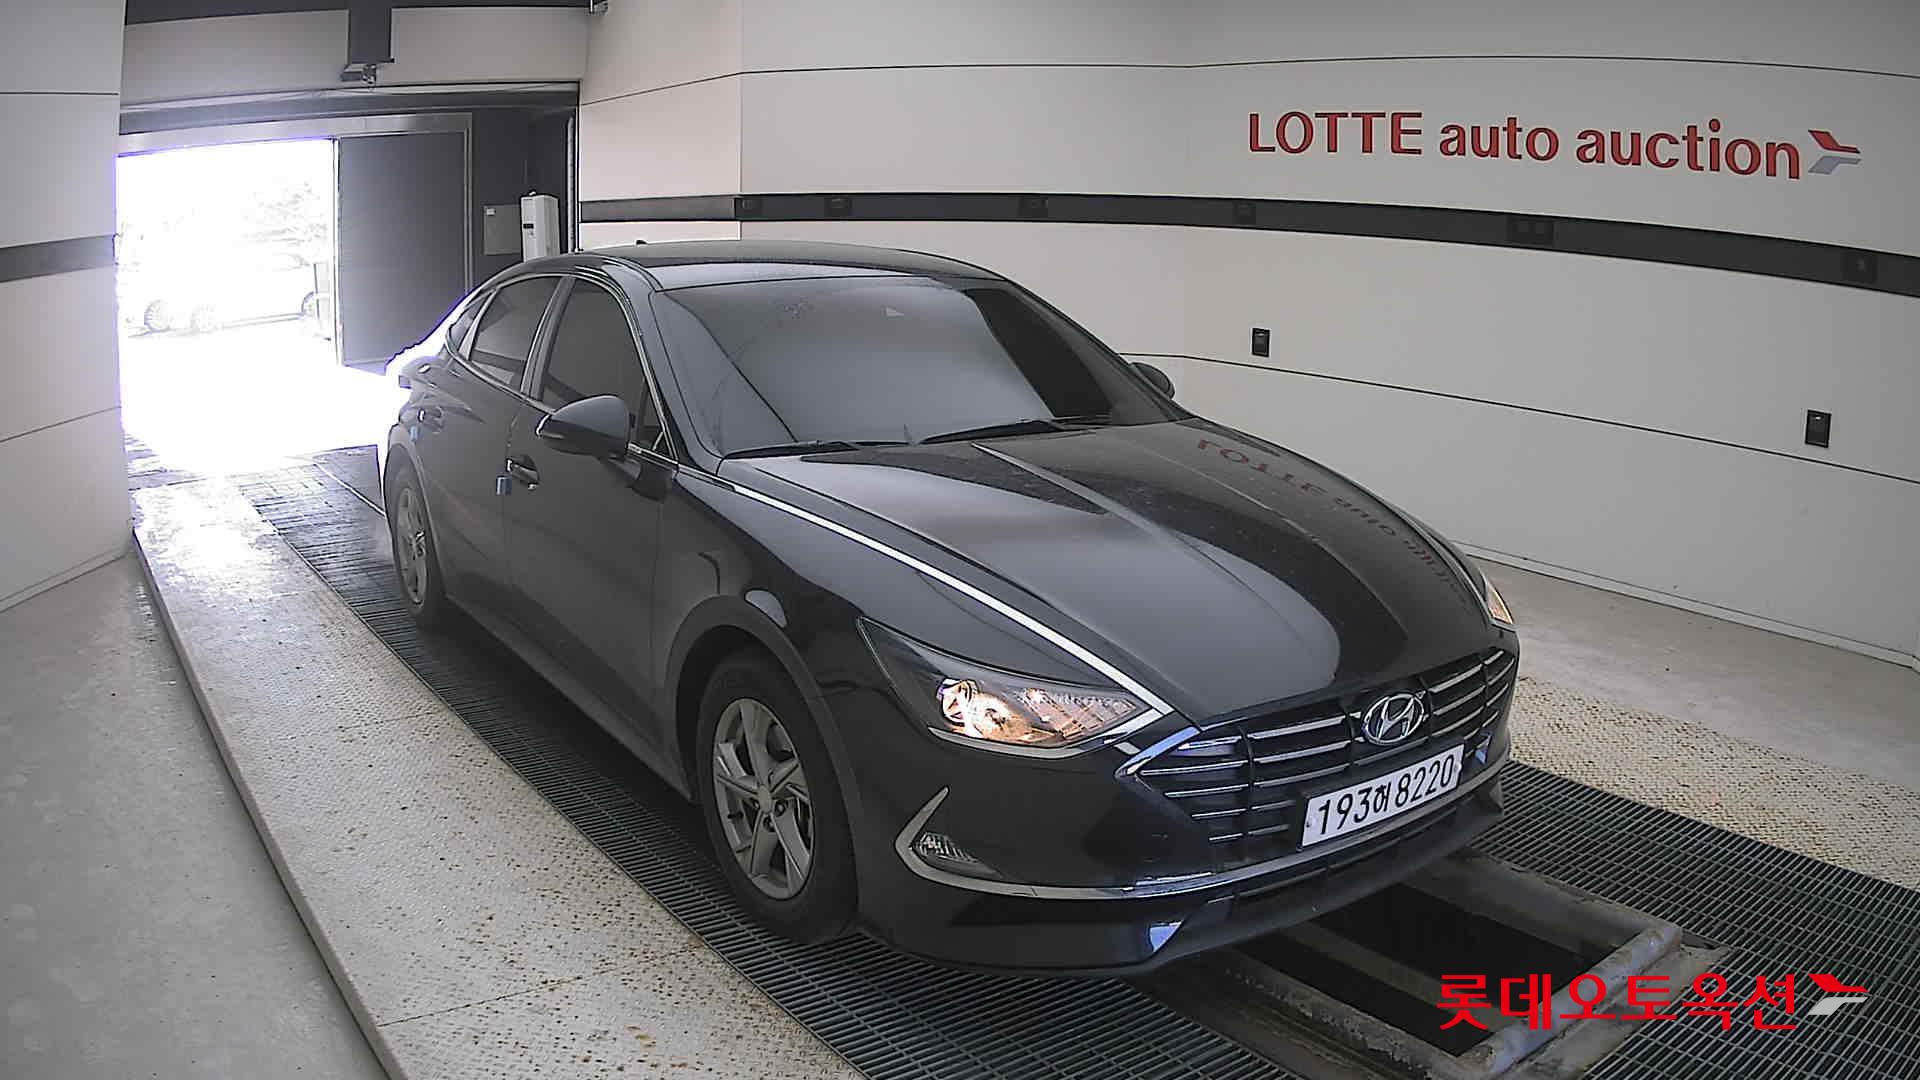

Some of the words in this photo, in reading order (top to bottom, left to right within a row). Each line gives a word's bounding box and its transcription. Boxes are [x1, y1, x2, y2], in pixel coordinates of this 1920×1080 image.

[1249, 112, 1423, 155] LOTTE
[1440, 117, 1559, 162] auto
[1576, 119, 1801, 181] auction
[1318, 781, 1392, 835] 193허
[1394, 754, 1455, 808] 8220
